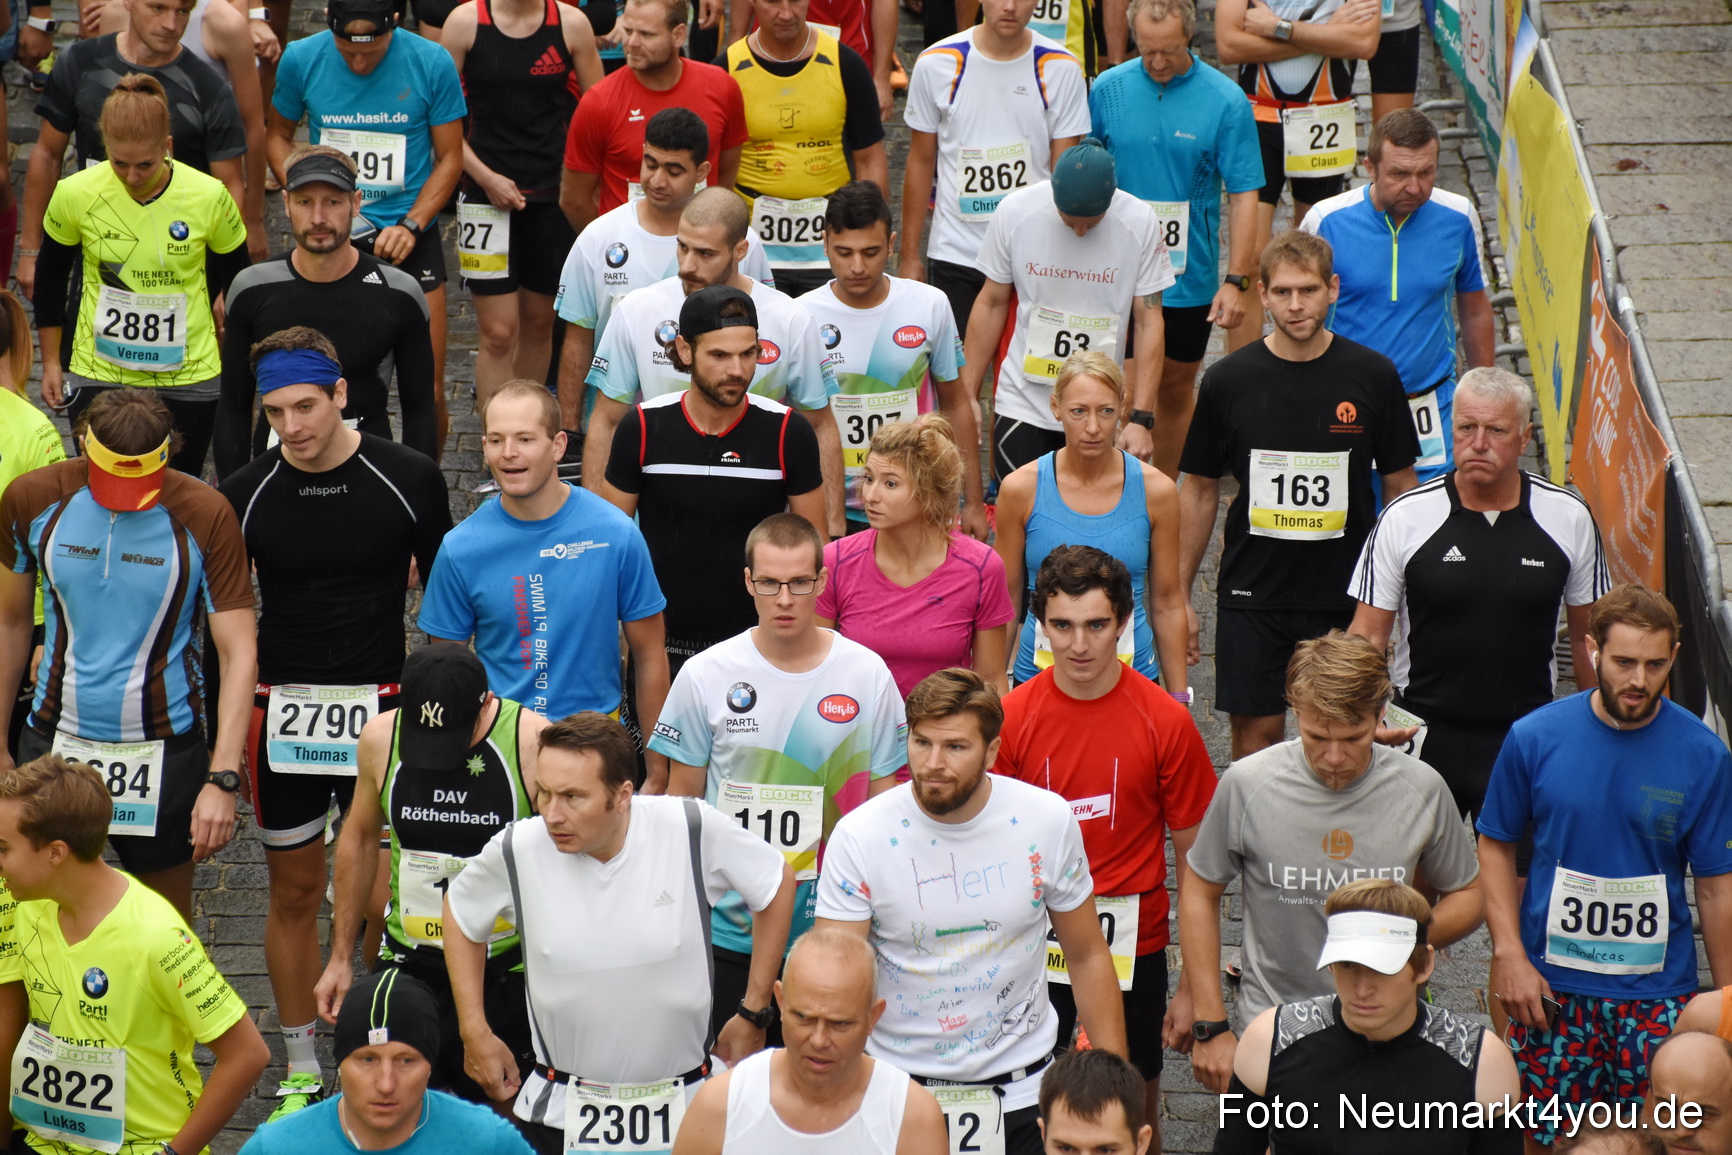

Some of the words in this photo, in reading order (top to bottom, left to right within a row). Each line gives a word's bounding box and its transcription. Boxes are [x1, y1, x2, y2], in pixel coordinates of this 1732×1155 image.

[530, 65, 566, 76] adidas
[321, 112, 409, 124] www.hasit.de
[1309, 122, 1340, 150] 22
[1310, 157, 1338, 168] Claus
[964, 159, 1028, 193] 2862
[972, 199, 1000, 212] Chris
[759, 214, 825, 242] 3029
[167, 242, 190, 253] Partl
[132, 270, 150, 279] THE
[603, 272, 629, 281] PARTL
[1025, 262, 1119, 284] Kaiserwinkl
[141, 279, 158, 288] 100
[102, 307, 176, 343] 2881
[897, 331, 925, 343] Hervis
[1053, 330, 1091, 358] 63
[117, 346, 160, 362] Verena
[868, 392, 910, 407] BOCK
[1294, 456, 1341, 468] BOCK
[298, 483, 349, 497] uhlsport
[1271, 473, 1330, 507] 163
[1272, 513, 1324, 529] Thomas
[1521, 557, 1545, 568] Herbert
[529, 573, 547, 613] SWIM
[512, 576, 532, 638] FINISHER
[534, 638, 549, 671] BIKE
[318, 688, 370, 703] BOCK
[823, 696, 856, 716] Hervis
[279, 702, 369, 740] 2790
[726, 718, 760, 727] PARTL
[726, 726, 760, 734] Neumarkt
[293, 745, 349, 763] Thomas
[433, 788, 469, 804] DAV
[759, 787, 815, 802] BOCK
[400, 806, 501, 826] Röthenbach
[735, 807, 801, 847] 110
[911, 851, 1010, 912] Herr
[1562, 881, 1598, 895] NeuerMarkt
[1603, 880, 1658, 894] BOCK
[1278, 893, 1318, 906] Anwalts-
[1560, 896, 1659, 938] 3058
[158, 943, 187, 968] zerbock
[1566, 941, 1626, 962] Andreas
[79, 1000, 108, 1018] Partl
[56, 1044, 113, 1065] BOCK
[21, 1056, 114, 1113] 2822
[618, 1082, 675, 1100] BOCK
[934, 1087, 993, 1102] BOCK
[43, 1110, 87, 1133] Lukas
[578, 1102, 670, 1146] 2301
